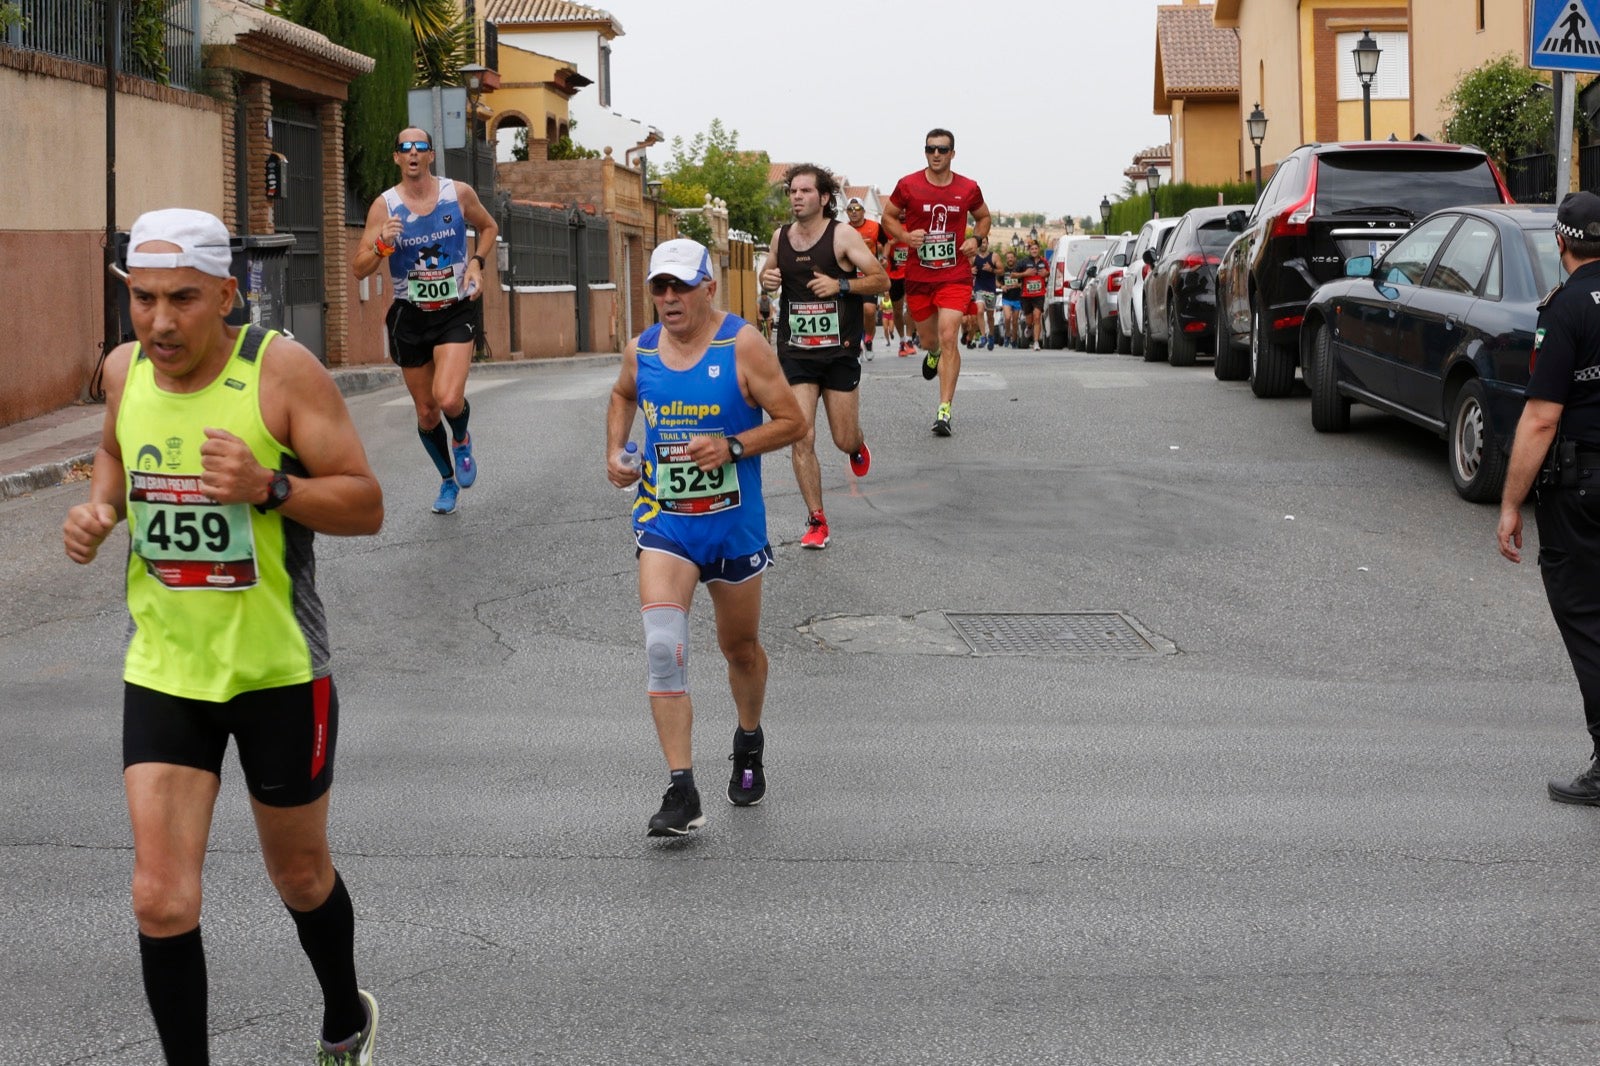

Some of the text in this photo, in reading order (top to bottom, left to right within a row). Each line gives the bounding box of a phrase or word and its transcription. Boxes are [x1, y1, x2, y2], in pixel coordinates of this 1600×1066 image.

[403, 228, 456, 247] TODO SUMA
[920, 243, 954, 258] 1136
[416, 281, 450, 299] 200
[796, 316, 831, 333] 219
[660, 401, 721, 420] olimpo
[660, 418, 698, 427] deportes
[659, 431, 680, 440] TRAIL
[681, 431, 688, 440] &
[669, 465, 724, 493] 529
[147, 510, 230, 552] 459
